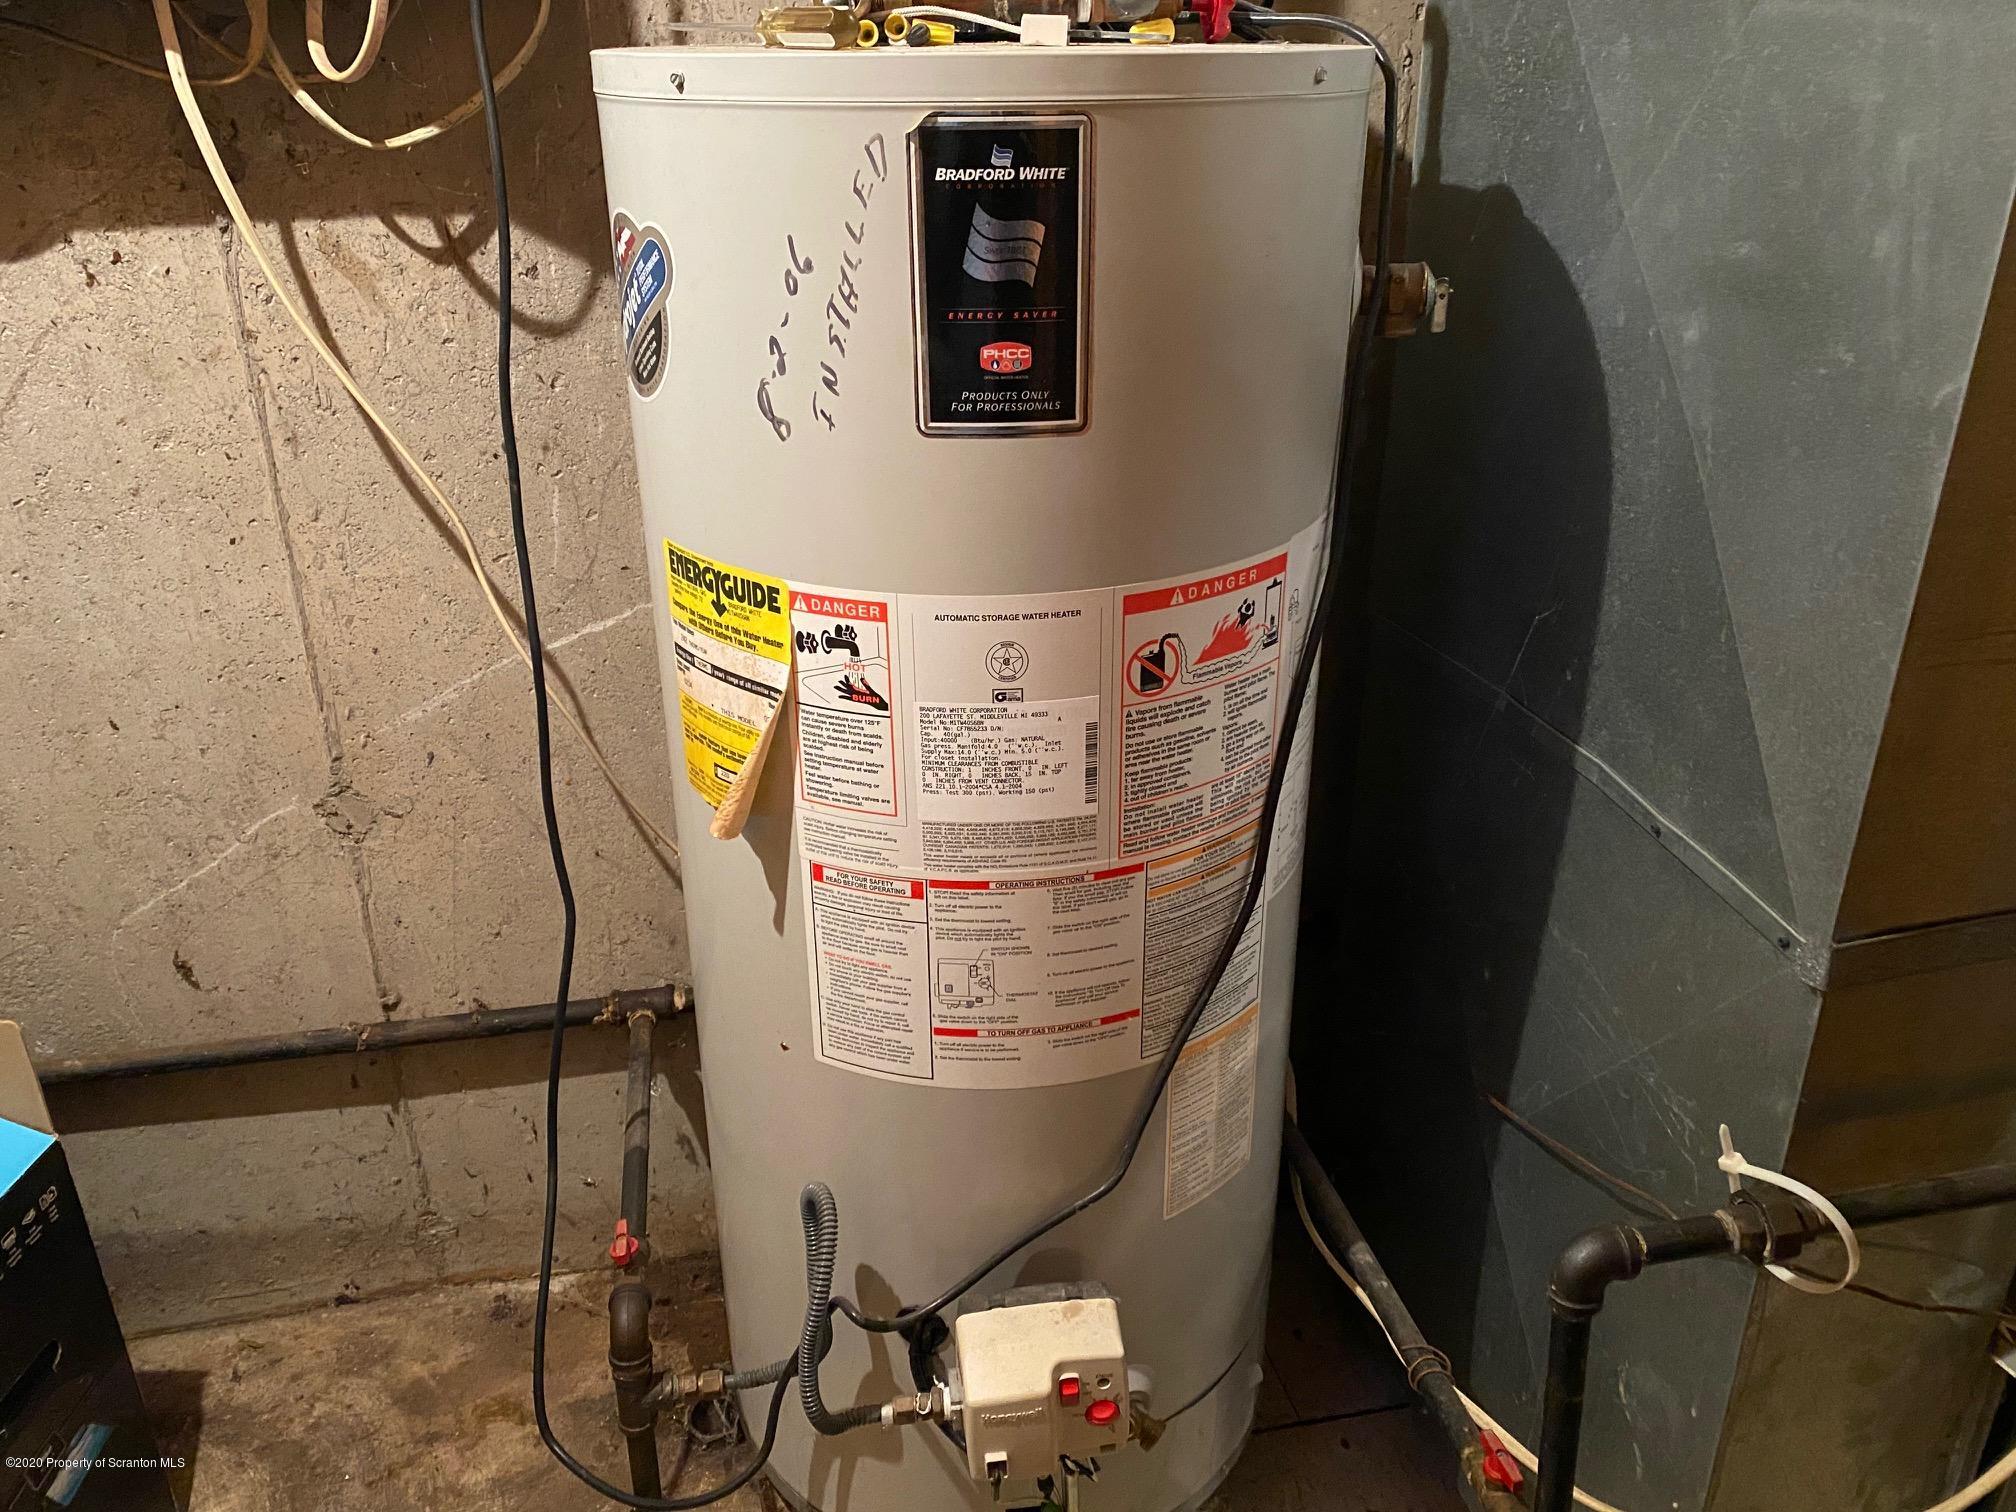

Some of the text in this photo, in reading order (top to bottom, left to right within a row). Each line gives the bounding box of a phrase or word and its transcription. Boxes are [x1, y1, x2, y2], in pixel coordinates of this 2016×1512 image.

[935, 167, 1067, 180] BRADFORD WHITE
[812, 133, 887, 432] INSTALLED
[1013, 311, 1057, 319] SAVER
[983, 349, 1030, 359] PHCC
[962, 391, 1050, 400] PRODUCTS ONLY
[951, 401, 1061, 412] FOR PROFESSIONALS
[669, 547, 780, 614] ENERGYGUIDE
[1188, 569, 1257, 599] DANGER
[811, 598, 880, 618] DANGER
[1022, 613, 1049, 621] WATER
[1051, 610, 1082, 619] HEATER
[843, 662, 866, 672] HOT
[852, 695, 880, 703] BURN
[1135, 707, 1157, 716] Vapors
[869, 879, 893, 887] SAFETY
[1036, 875, 1085, 887] INSTRUCTIONS
[843, 880, 867, 889] BEFORE
[869, 885, 906, 895] OPERATING
[1057, 1022, 1092, 1032] APPLIANCE
